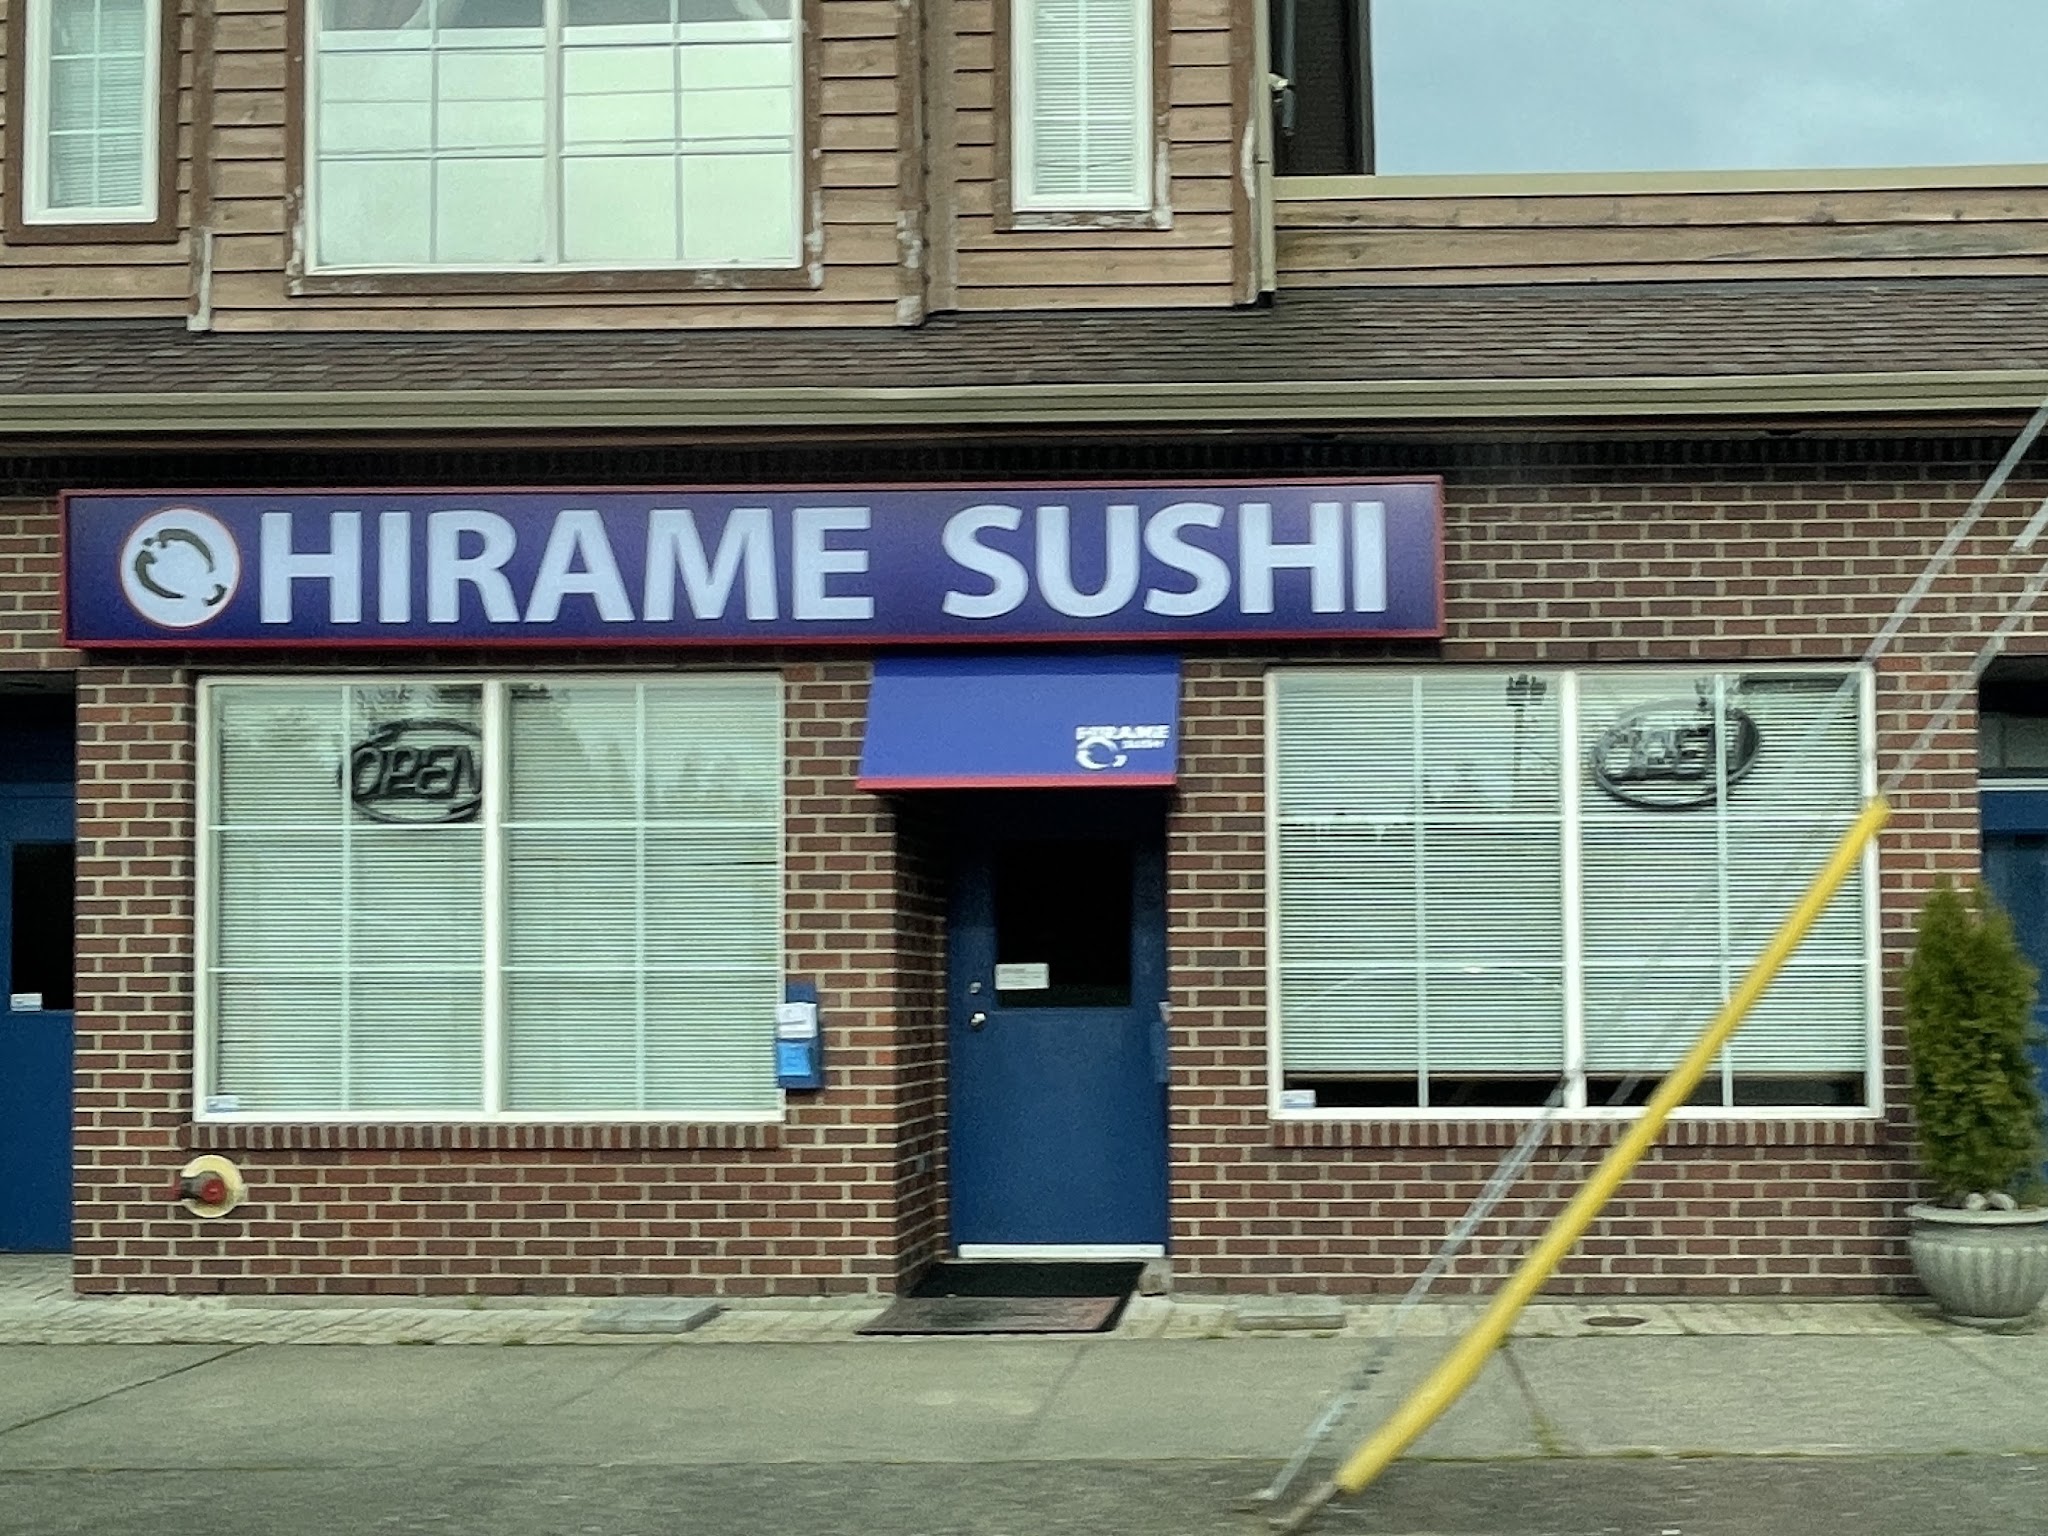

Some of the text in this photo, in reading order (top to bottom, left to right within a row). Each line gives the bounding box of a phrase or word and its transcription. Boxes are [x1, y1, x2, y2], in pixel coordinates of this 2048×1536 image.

[260, 502, 1387, 623] HIRAME SUSHI
[352, 744, 482, 797] OPEN
